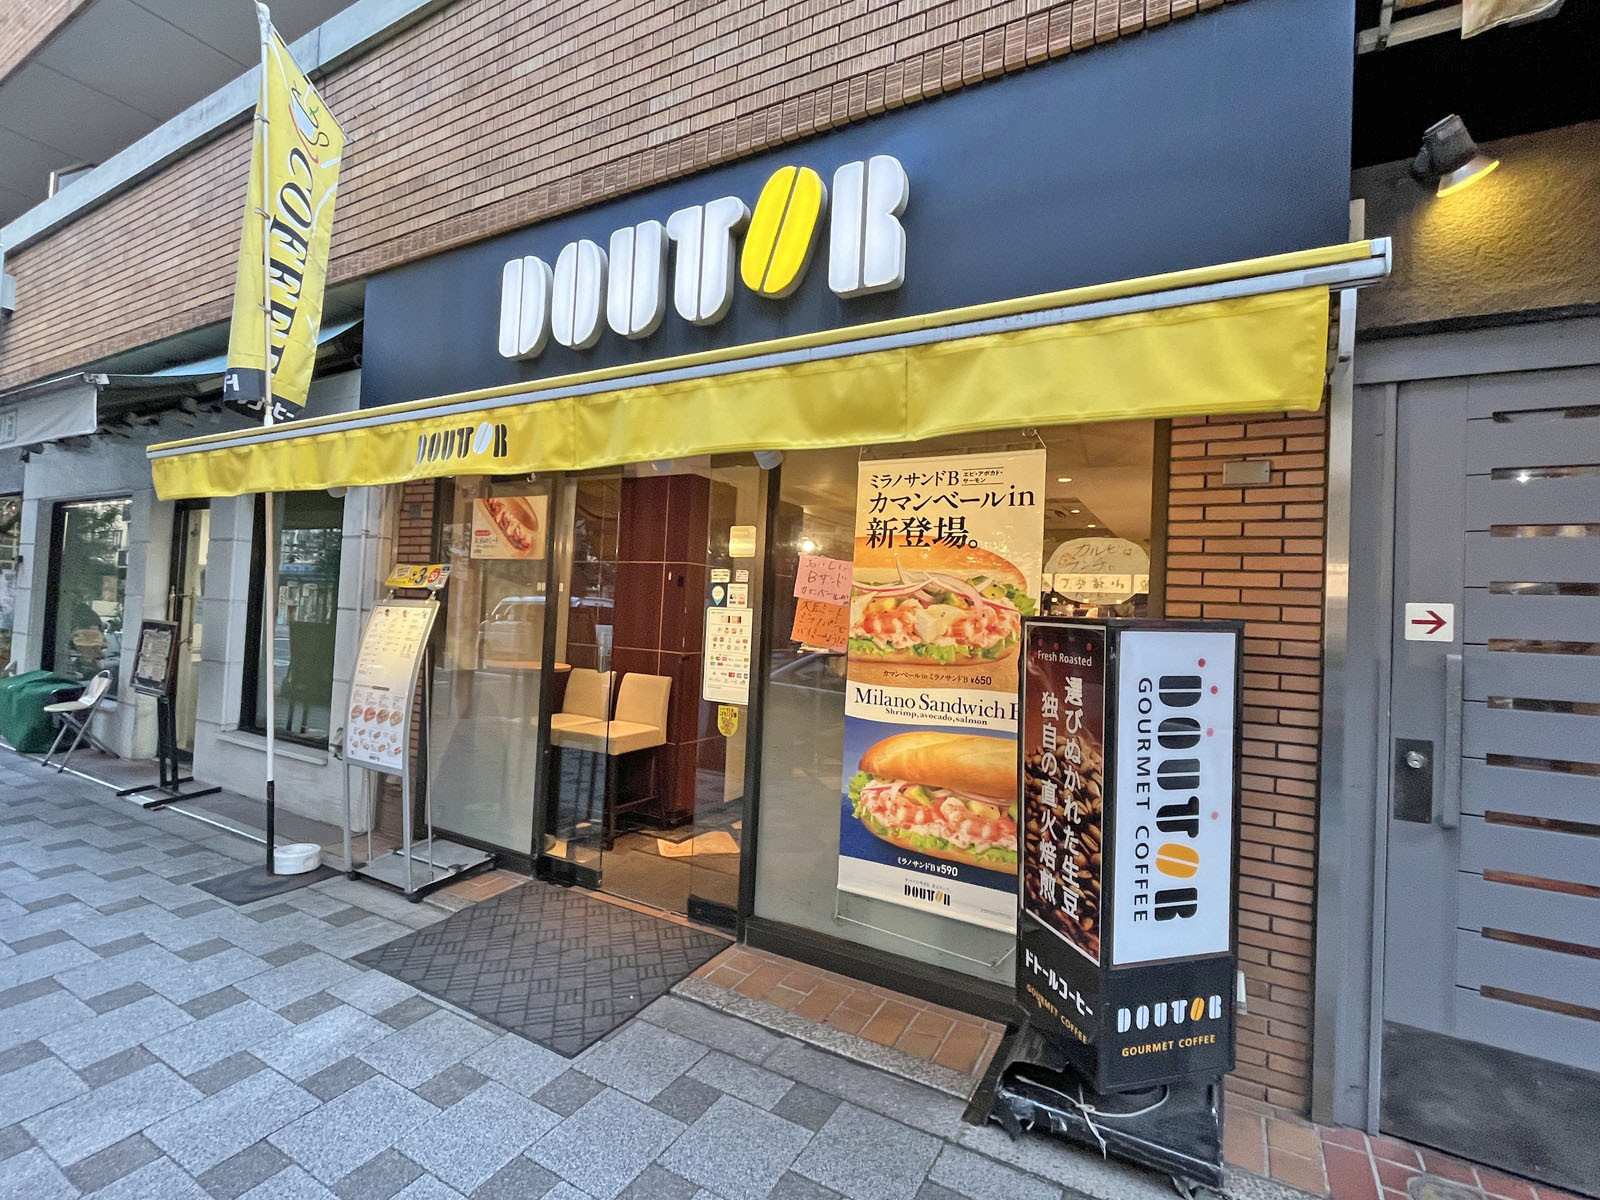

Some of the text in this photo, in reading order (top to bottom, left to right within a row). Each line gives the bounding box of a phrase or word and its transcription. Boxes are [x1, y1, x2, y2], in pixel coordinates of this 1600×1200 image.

[499, 155, 910, 361] DOUTOR
[416, 421, 508, 464] DOUTOR
[870, 470, 959, 489] ミラノサンドB
[866, 516, 978, 549] 新登場。
[1037, 651, 1093, 668] Fresh Roasted
[970, 676, 992, 685] ¥650
[855, 688, 916, 709] Milano
[918, 693, 1005, 719] Sandwich
[1039, 692, 1060, 908] 独自の直火焙煎
[1061, 676, 1085, 922] 選びぬかれた生豆
[1133, 678, 1153, 922] GOURMET COFFEE
[1154, 675, 1202, 922] DOUTOR
[936, 864, 959, 877] ¥590
[904, 884, 951, 906] DOUTOR
[1025, 949, 1094, 1017] ドトールコーヒー
[1026, 983, 1088, 1045] GOURMET COFFEE
[1117, 994, 1222, 1033] DOUTOR
[1121, 1034, 1216, 1058] GOURMET COFFEE
